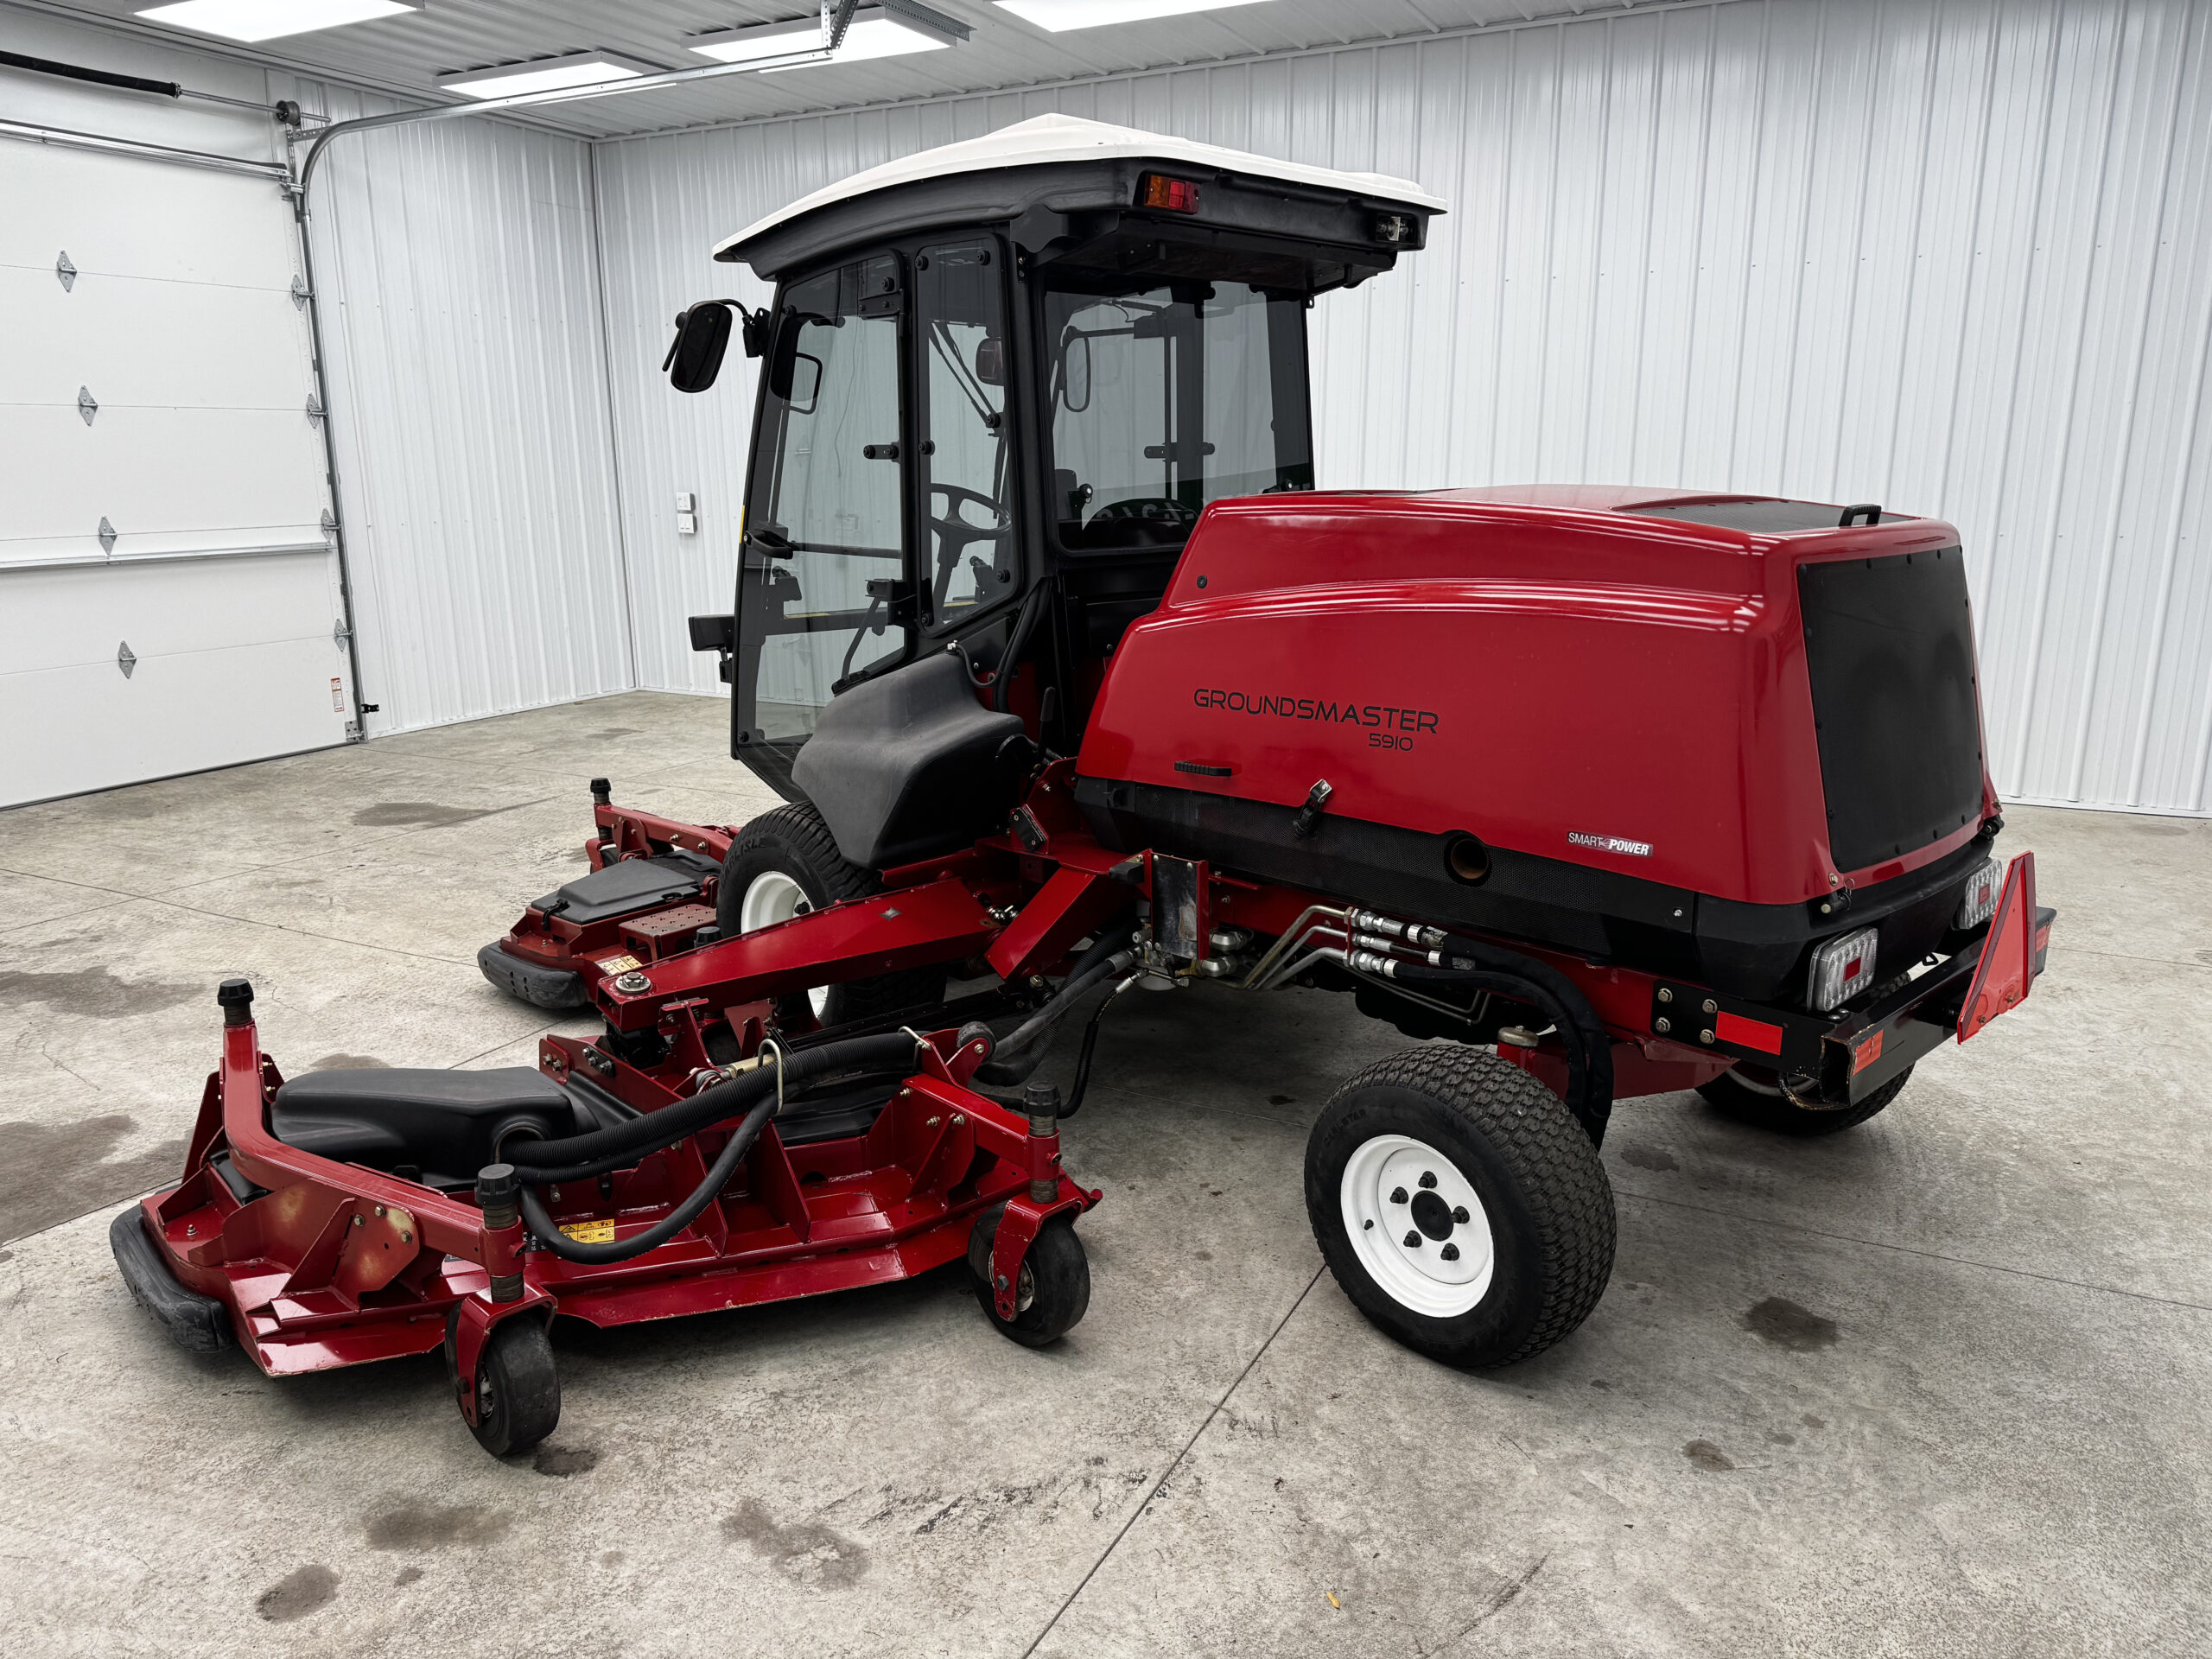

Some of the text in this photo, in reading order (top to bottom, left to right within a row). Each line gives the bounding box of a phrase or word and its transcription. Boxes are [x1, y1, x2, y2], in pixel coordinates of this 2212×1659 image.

[1193, 689, 1440, 734] GROUNDSMASTER
[1368, 733, 1414, 752] 5910
[1568, 831, 1649, 855] SMART POWER
